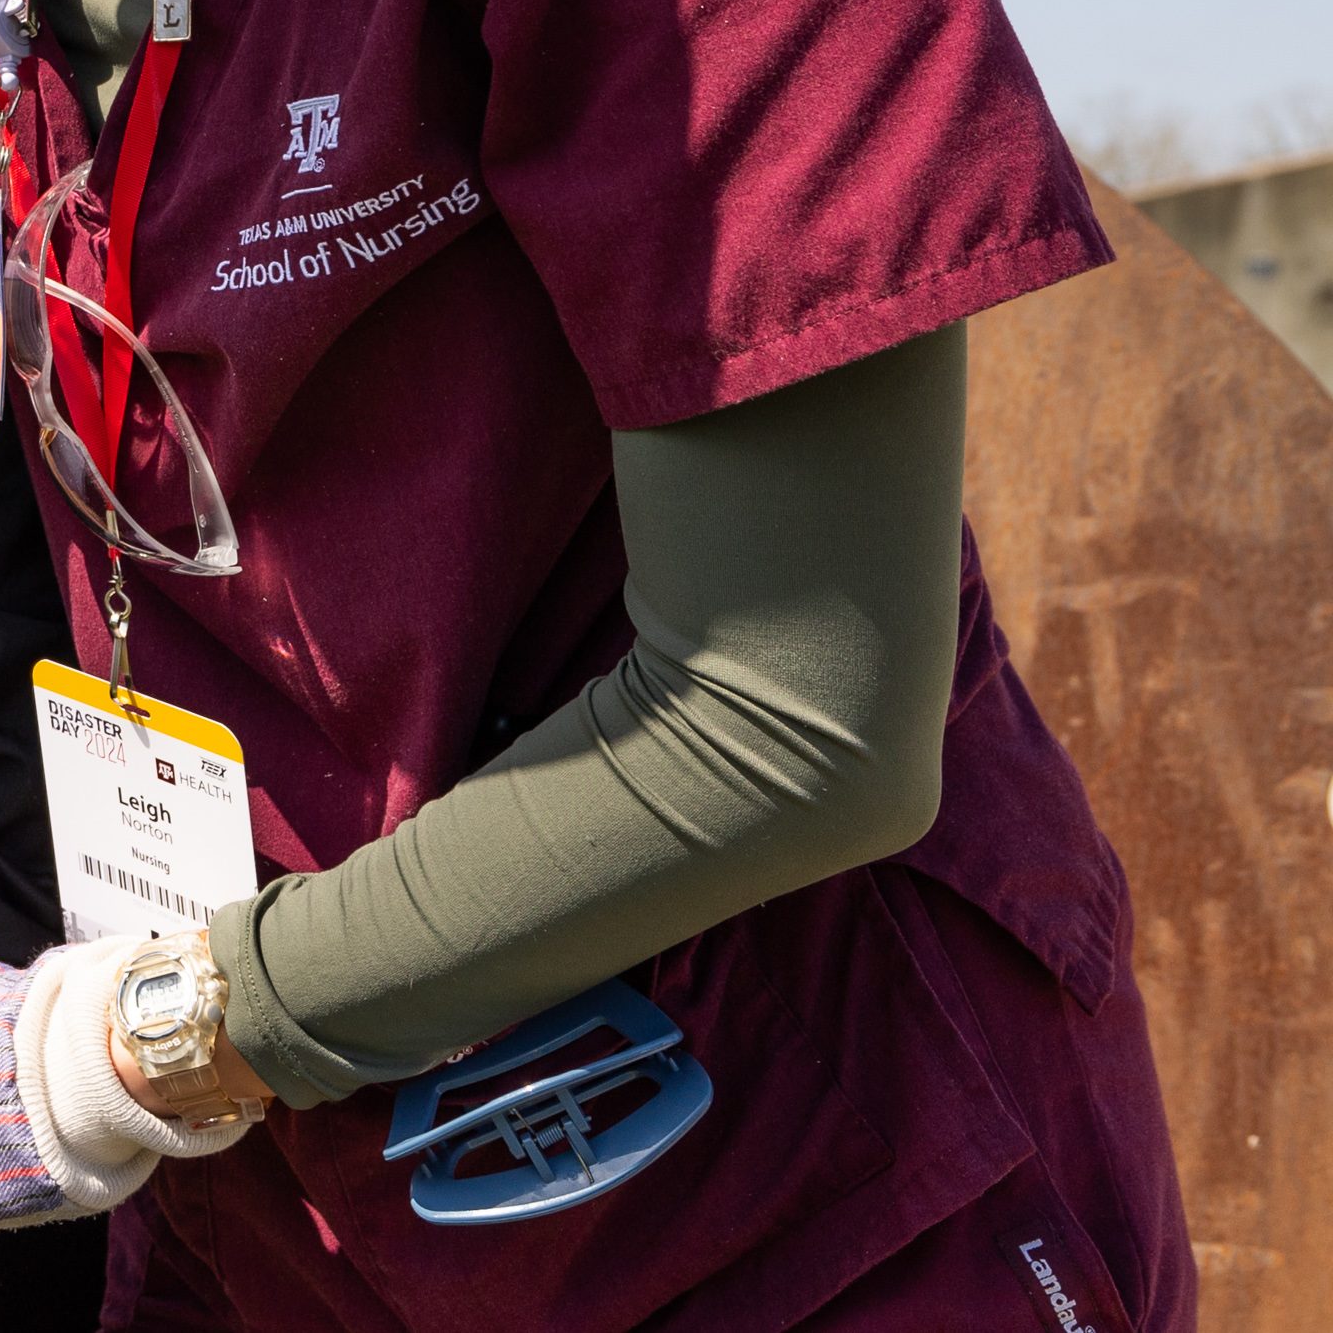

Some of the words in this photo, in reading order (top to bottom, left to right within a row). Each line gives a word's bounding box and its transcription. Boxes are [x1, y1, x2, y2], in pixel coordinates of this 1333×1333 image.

[163, 4, 181, 28] L
[239, 217, 271, 246] TEXAS
[275, 214, 308, 238] A&M
[310, 174, 425, 231] UNIVERSITY
[211, 248, 294, 291] School
[299, 242, 332, 278] of
[336, 178, 481, 270] Nursing
[48, 699, 123, 741] DISASTER
[50, 714, 81, 739] DAY
[84, 728, 127, 767] 2024
[117, 786, 172, 824] Leigh
[179, 772, 233, 804] HEALTH
[121, 811, 174, 845] Norton
[131, 846, 171, 875] Nursing
